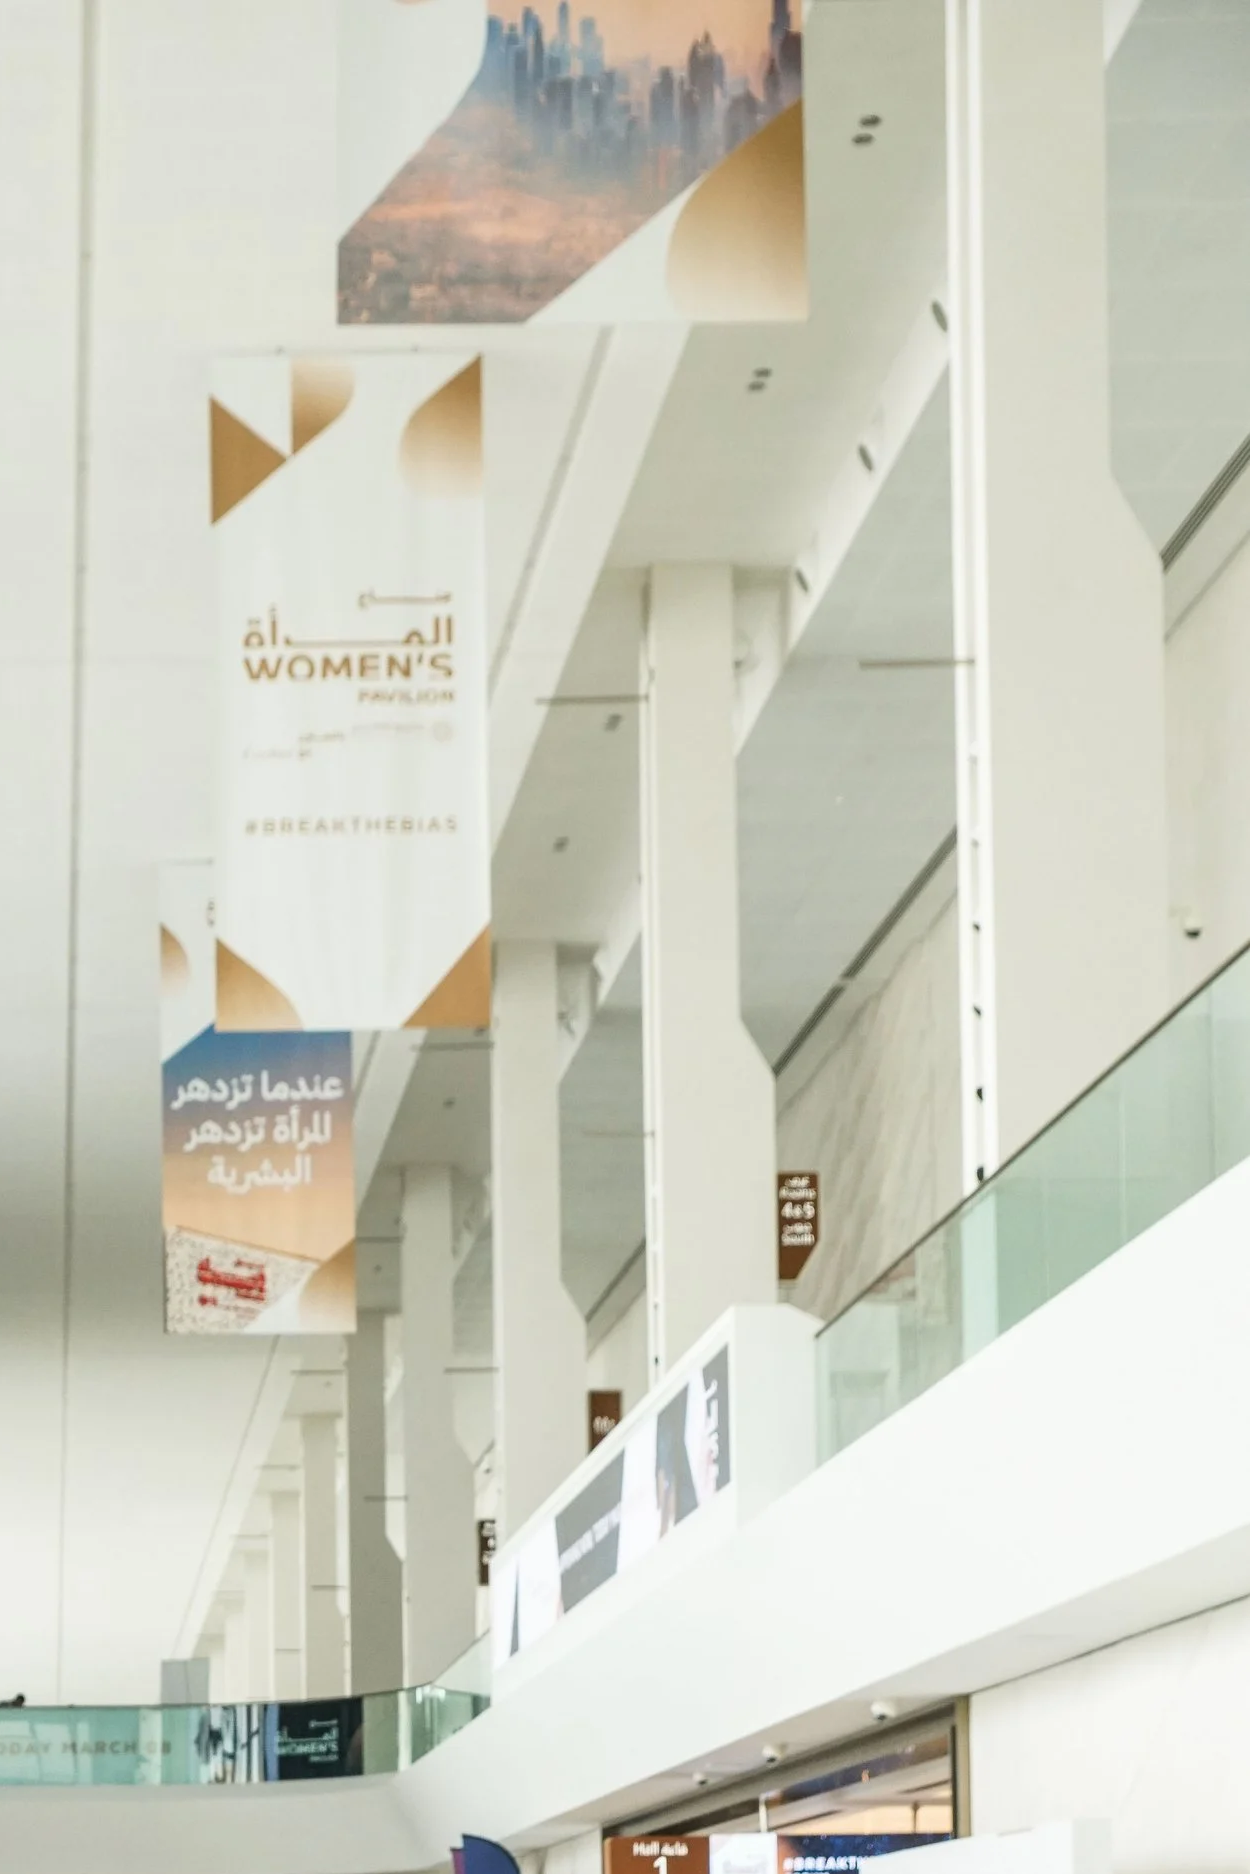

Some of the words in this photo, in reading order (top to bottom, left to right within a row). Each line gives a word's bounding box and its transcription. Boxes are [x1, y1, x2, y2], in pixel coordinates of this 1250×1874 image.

[241, 651, 456, 684] WOMEN'S
[357, 688, 456, 704] PAVILION
[244, 814, 458, 836] #BREAKTHEBIAS
[170, 1073, 254, 1110] تزدهر
[261, 1069, 345, 1101] عندما
[182, 1115, 266, 1152] تزدهر
[207, 1153, 312, 1194] البشرية
[61, 1740, 138, 1755] MARCH
[632, 1841, 660, 1856] Hall
